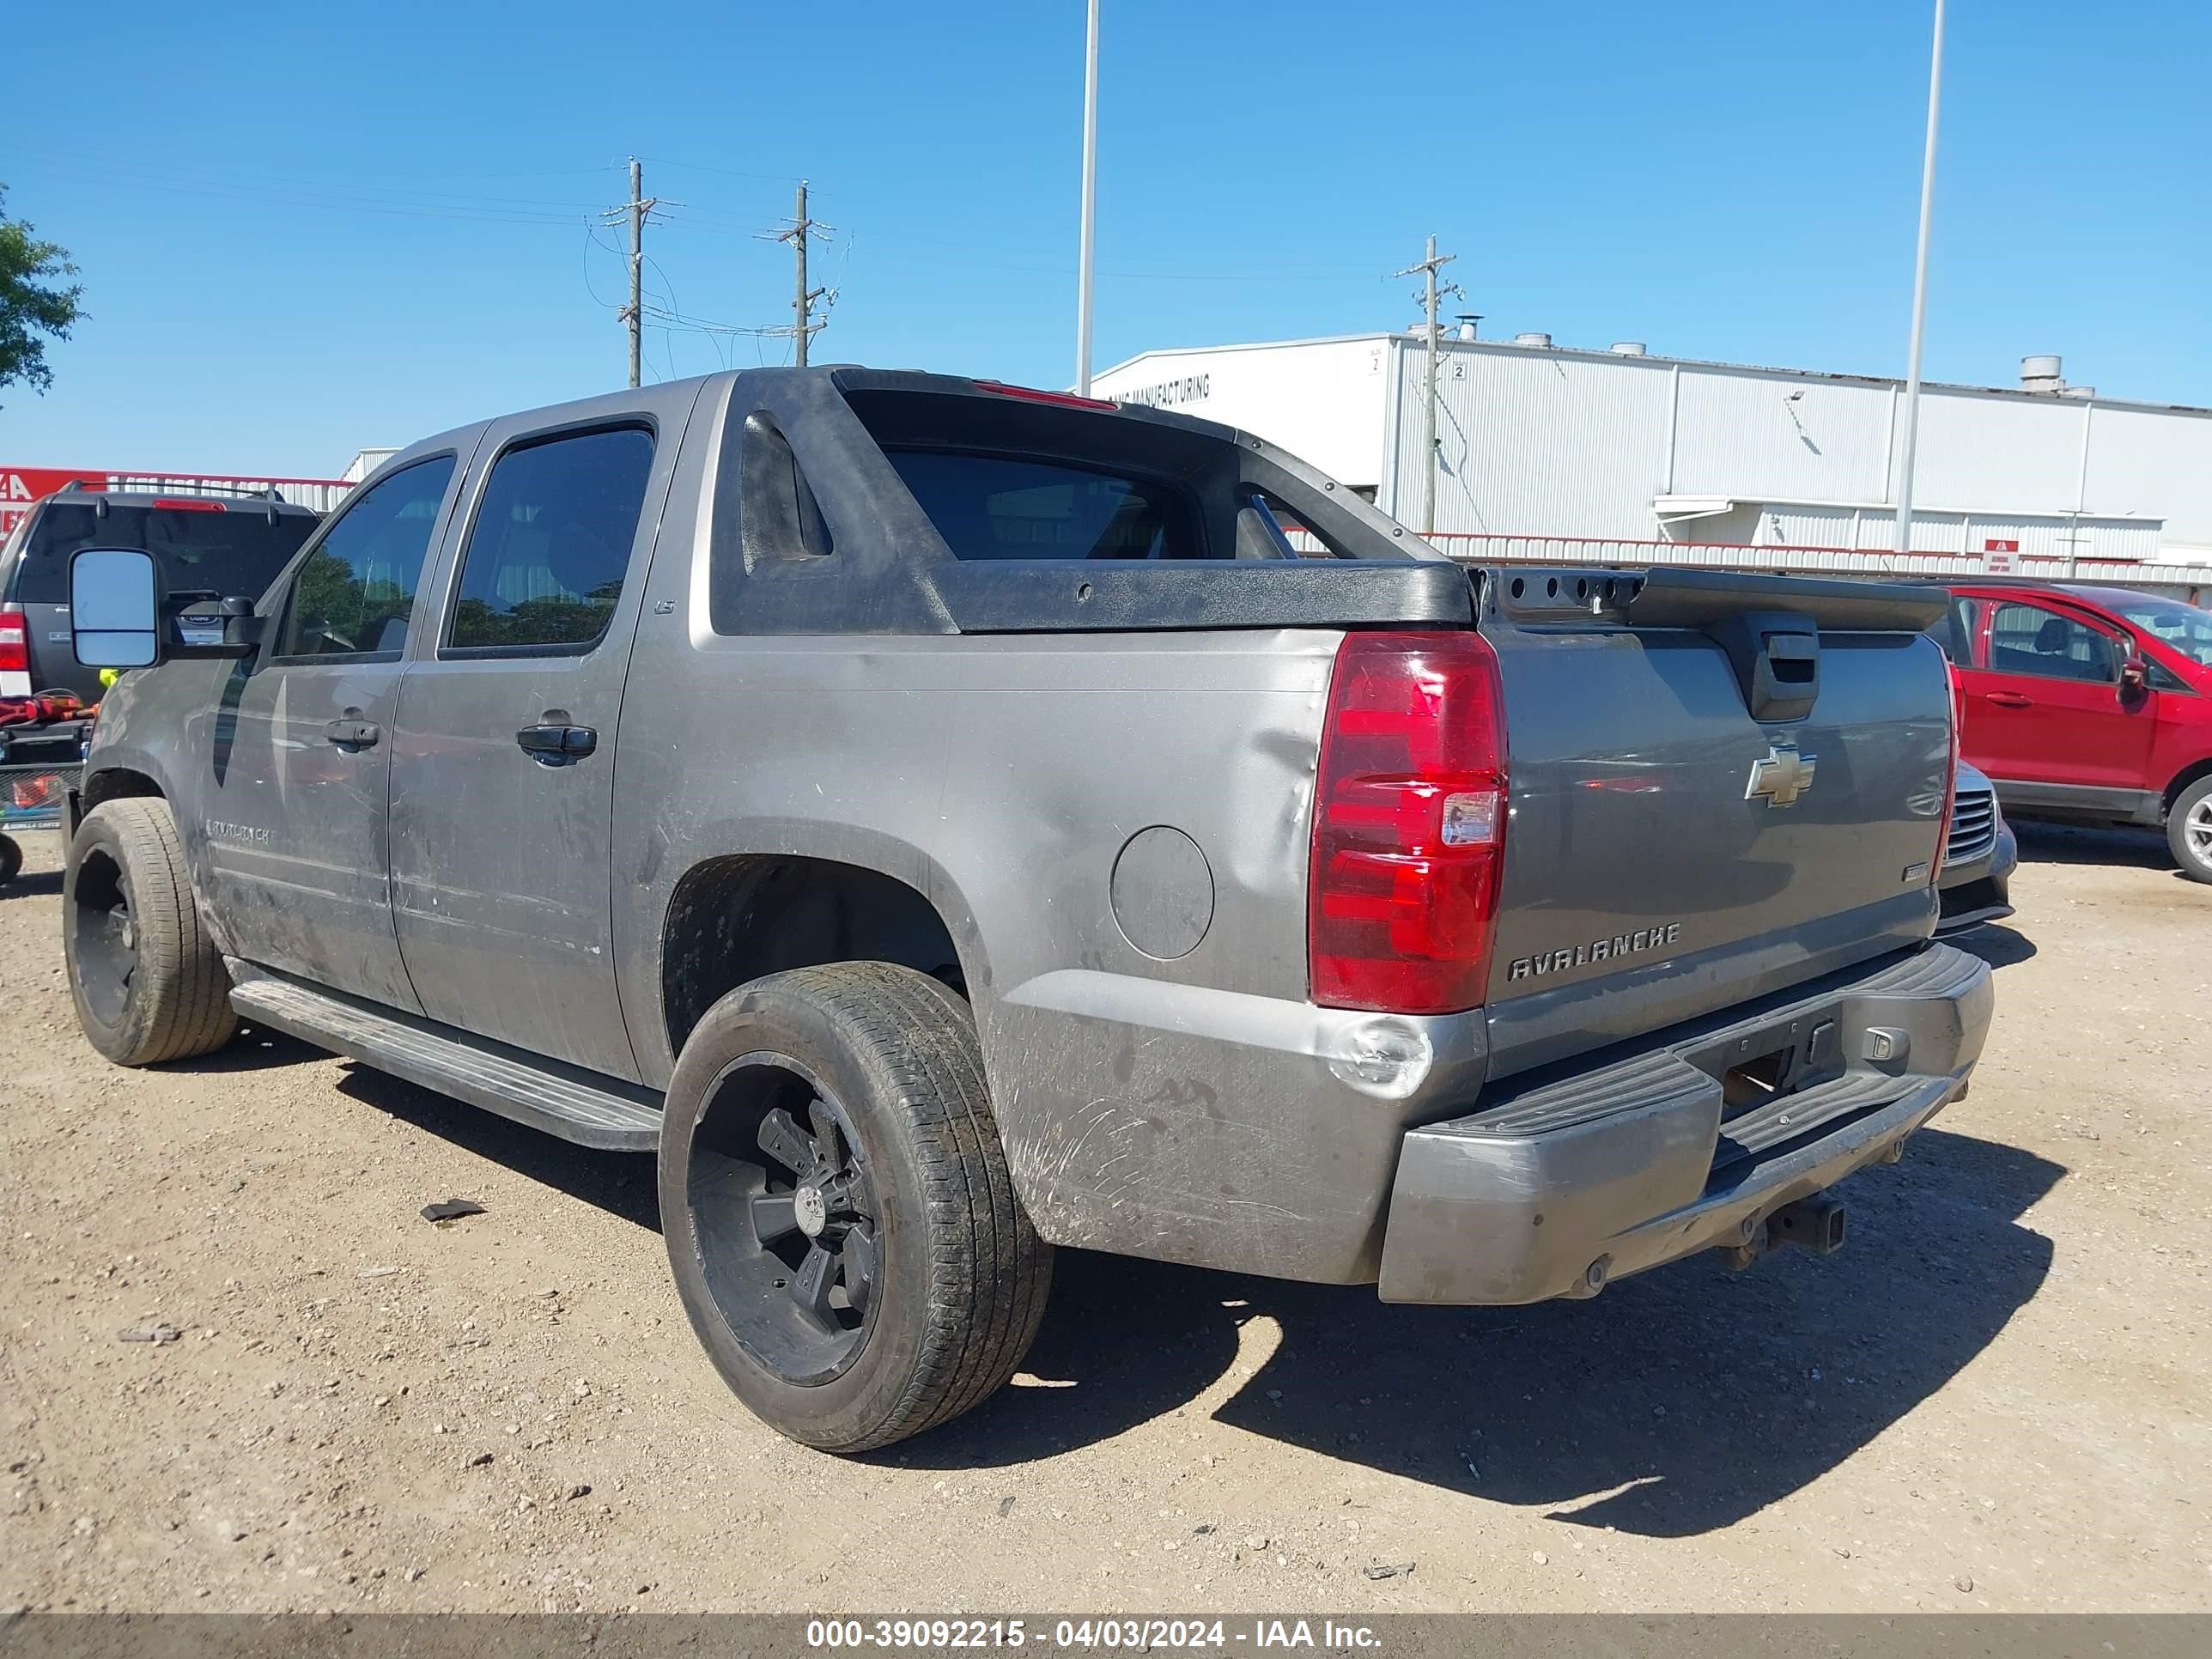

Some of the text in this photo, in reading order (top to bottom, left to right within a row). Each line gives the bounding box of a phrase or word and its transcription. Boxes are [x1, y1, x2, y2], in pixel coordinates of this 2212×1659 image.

[1455, 366, 1463, 377] 2
[1133, 374, 1209, 408] MANUFACTURING
[1507, 923, 1680, 981] AVALANCHE
